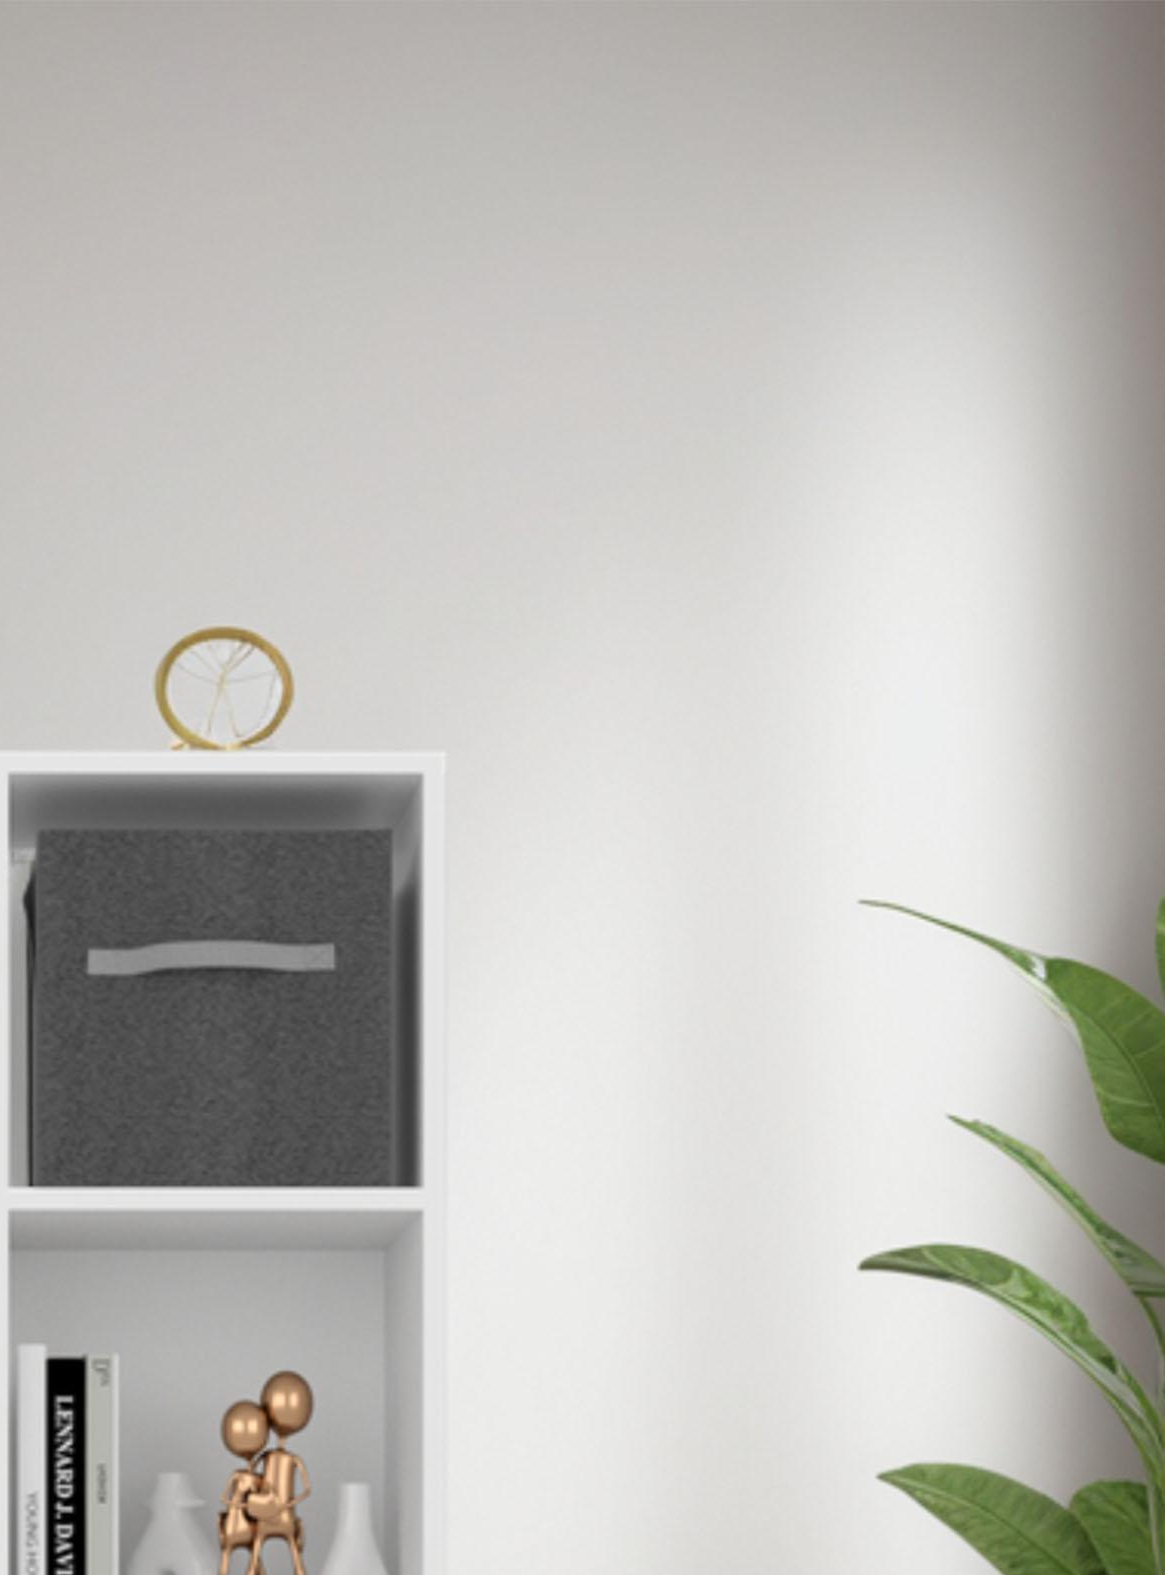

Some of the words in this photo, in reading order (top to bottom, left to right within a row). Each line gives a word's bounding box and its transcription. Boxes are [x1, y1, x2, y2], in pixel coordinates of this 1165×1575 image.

[54, 1394, 75, 1500] LENNARD
[25, 1490, 40, 1549] YOUNG
[54, 1501, 75, 1520] J.
